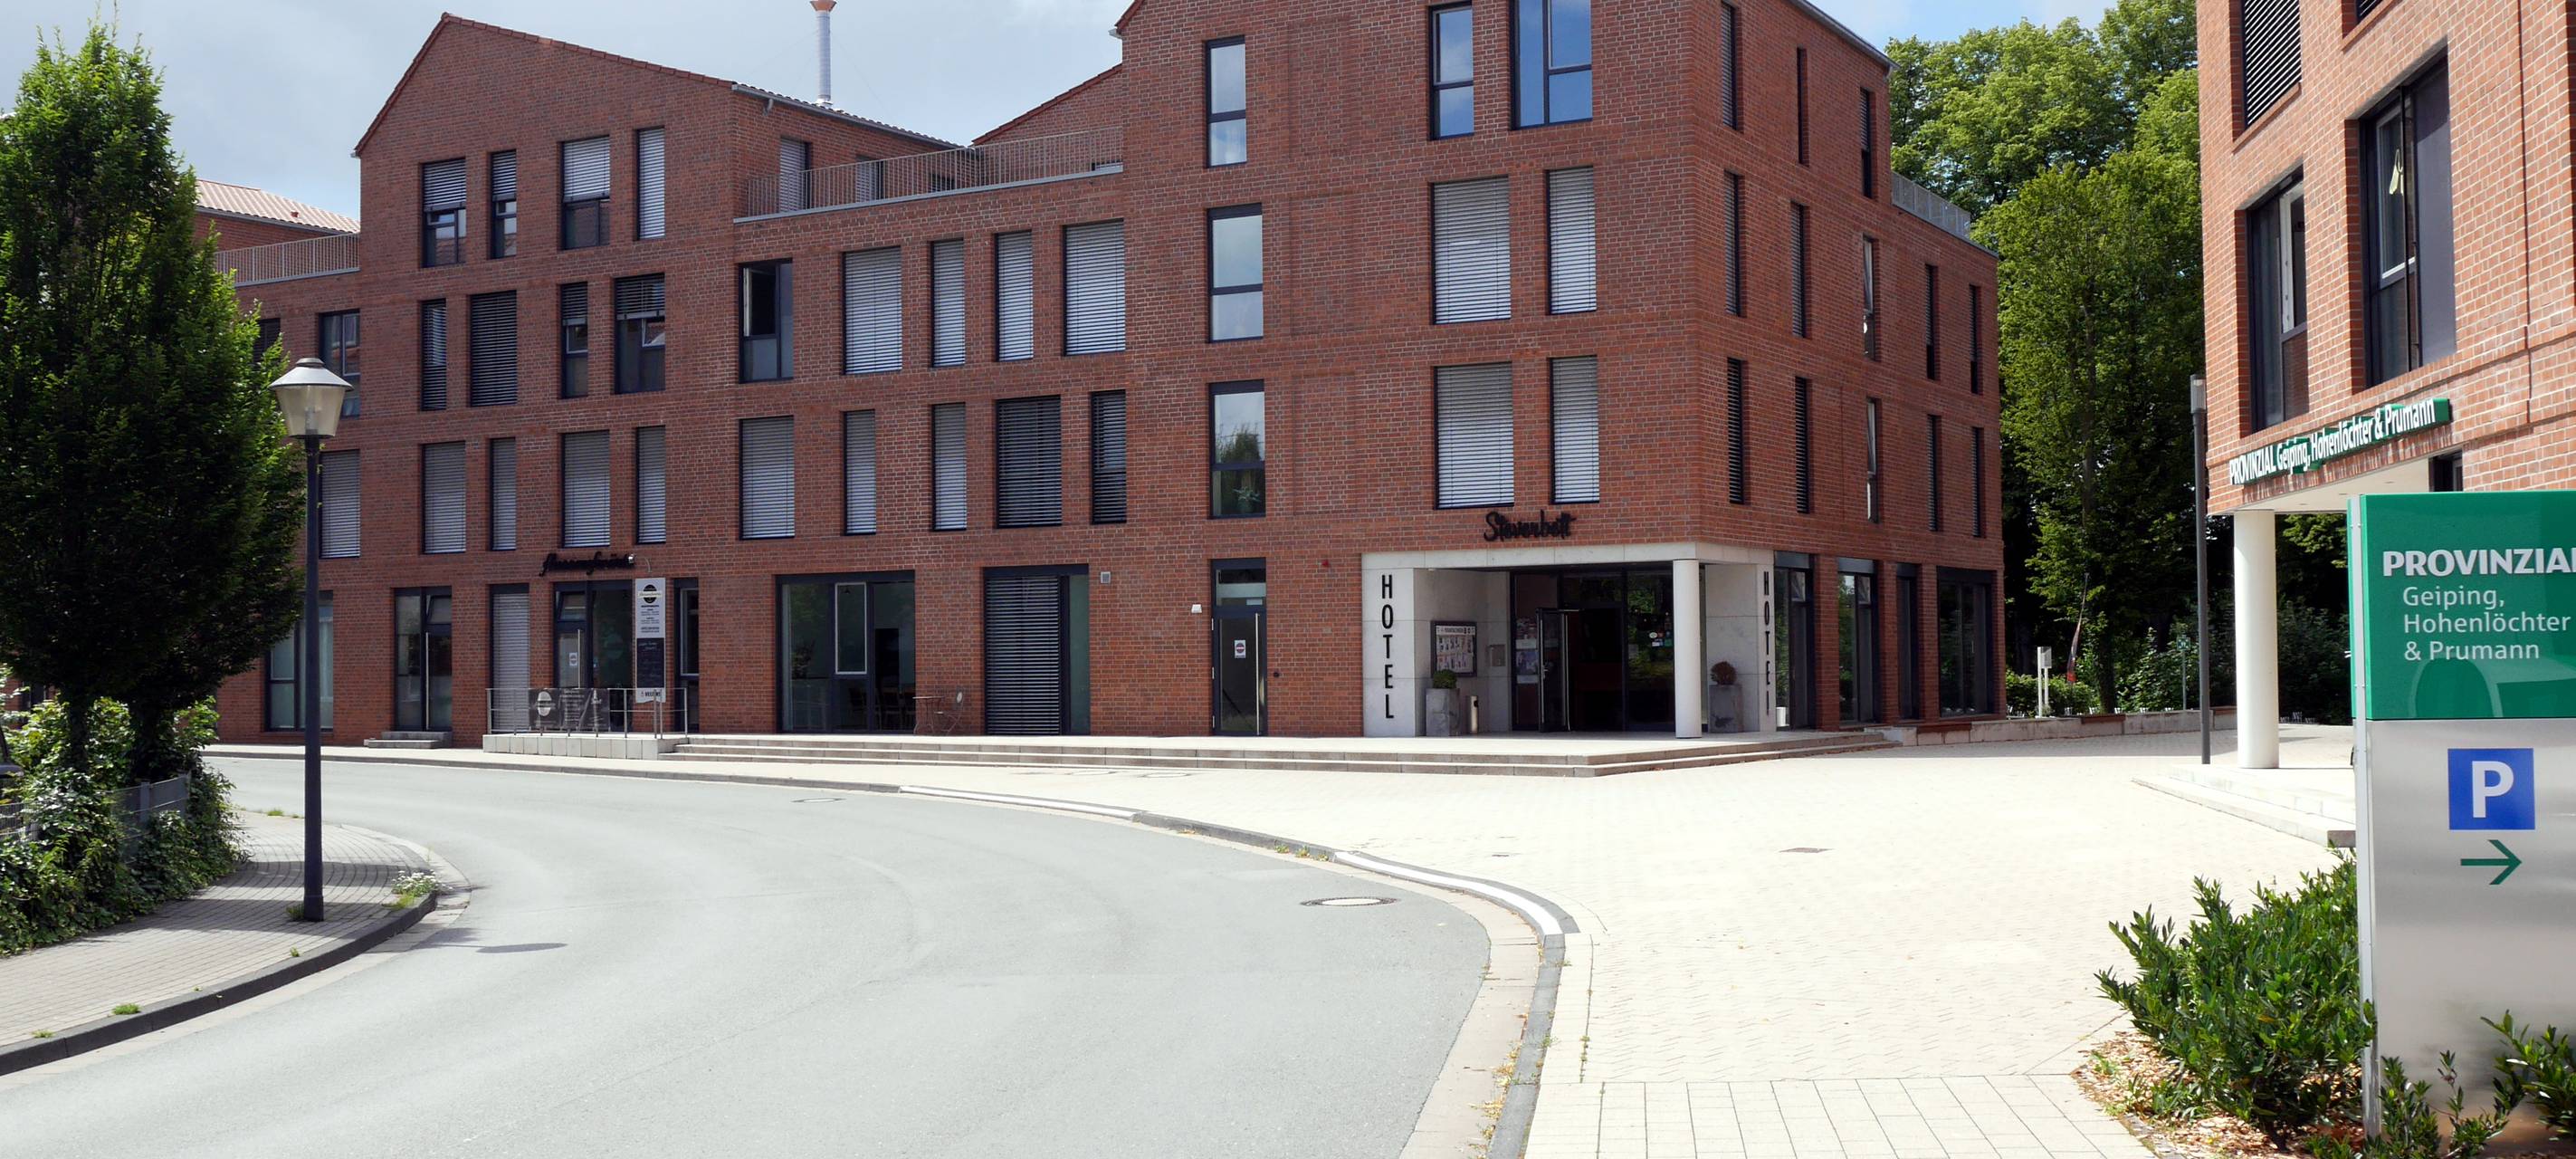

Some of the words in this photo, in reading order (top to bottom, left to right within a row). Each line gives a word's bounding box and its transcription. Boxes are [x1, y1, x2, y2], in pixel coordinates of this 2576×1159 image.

[2229, 445, 2275, 485] PROVINZIAL
[2276, 439, 2310, 475] Geiping,
[2310, 420, 2373, 461] Hohenlöchter
[2374, 408, 2384, 439] &
[2384, 398, 2436, 436] Prumann
[2383, 547, 2576, 577] PROVINZIA
[2403, 585, 2504, 610] Geiping,
[2404, 611, 2571, 634] Hohenlöchter
[1381, 574, 1395, 719] HOTEL
[2404, 641, 2421, 661] &
[2429, 641, 2540, 661] Prumann
[2472, 761, 2514, 819] P
